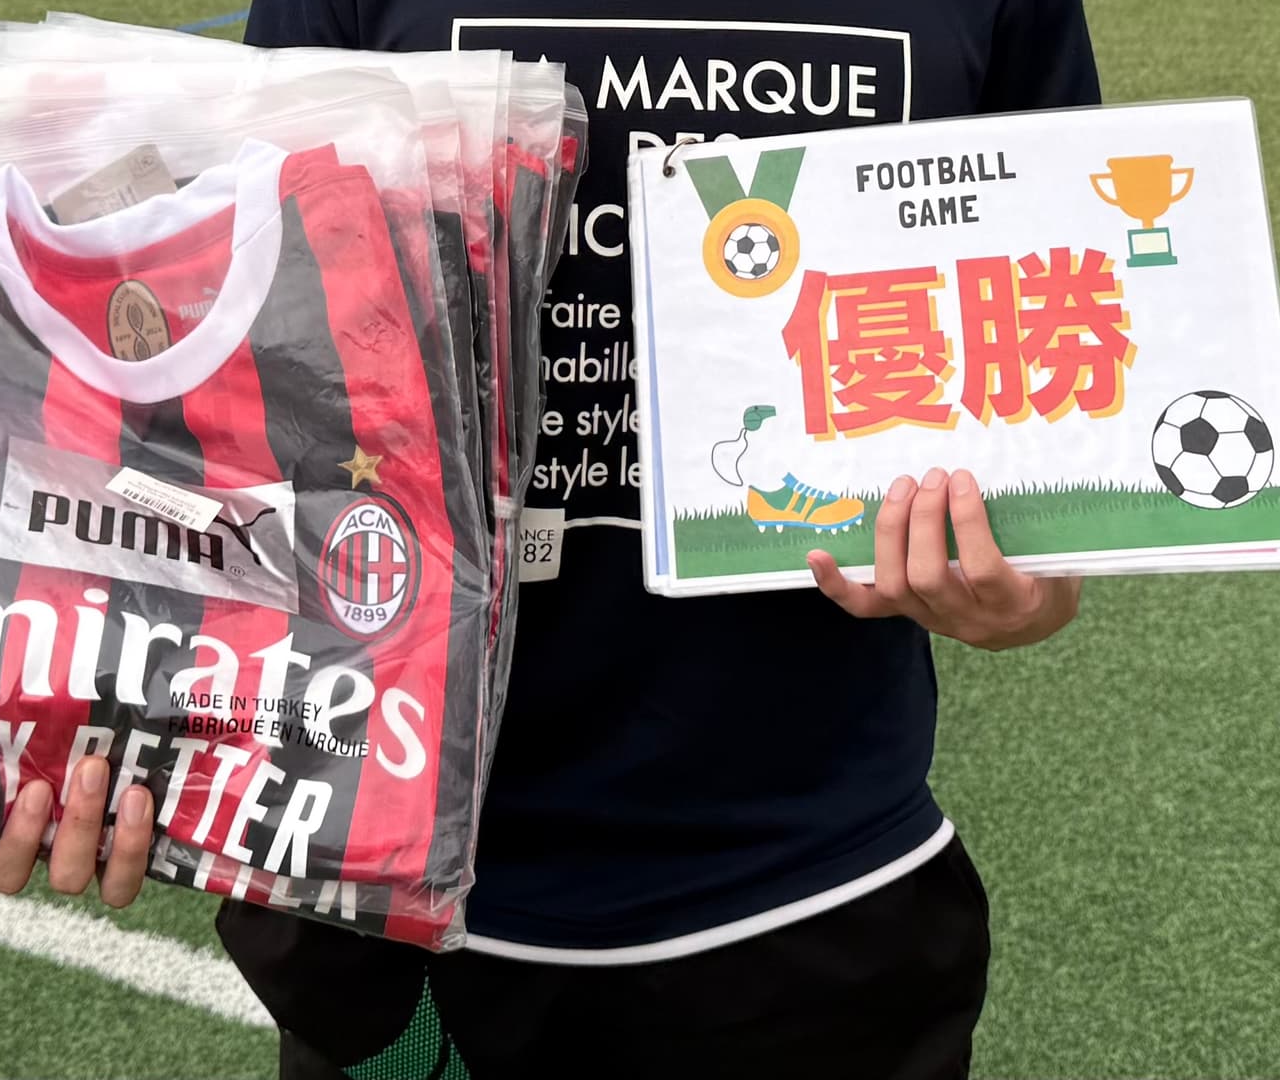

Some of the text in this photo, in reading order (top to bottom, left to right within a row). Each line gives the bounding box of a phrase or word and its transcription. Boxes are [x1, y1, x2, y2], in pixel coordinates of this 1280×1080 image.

[596, 55, 877, 118] MARQUE
[856, 152, 1016, 192] FOOTBALL
[899, 195, 980, 228] GAME
[781, 247, 1138, 441] 優勝
[533, 448, 608, 500] style
[28, 490, 224, 571] PUMA
[341, 509, 393, 536] ACM
[523, 543, 553, 563] 82
[343, 604, 387, 622] 1899
[170, 691, 322, 722] MADE IN TURKEY
[168, 715, 370, 758] FABRIQUÉ EN TURQUIE
[60, 725, 334, 877] BETTER
